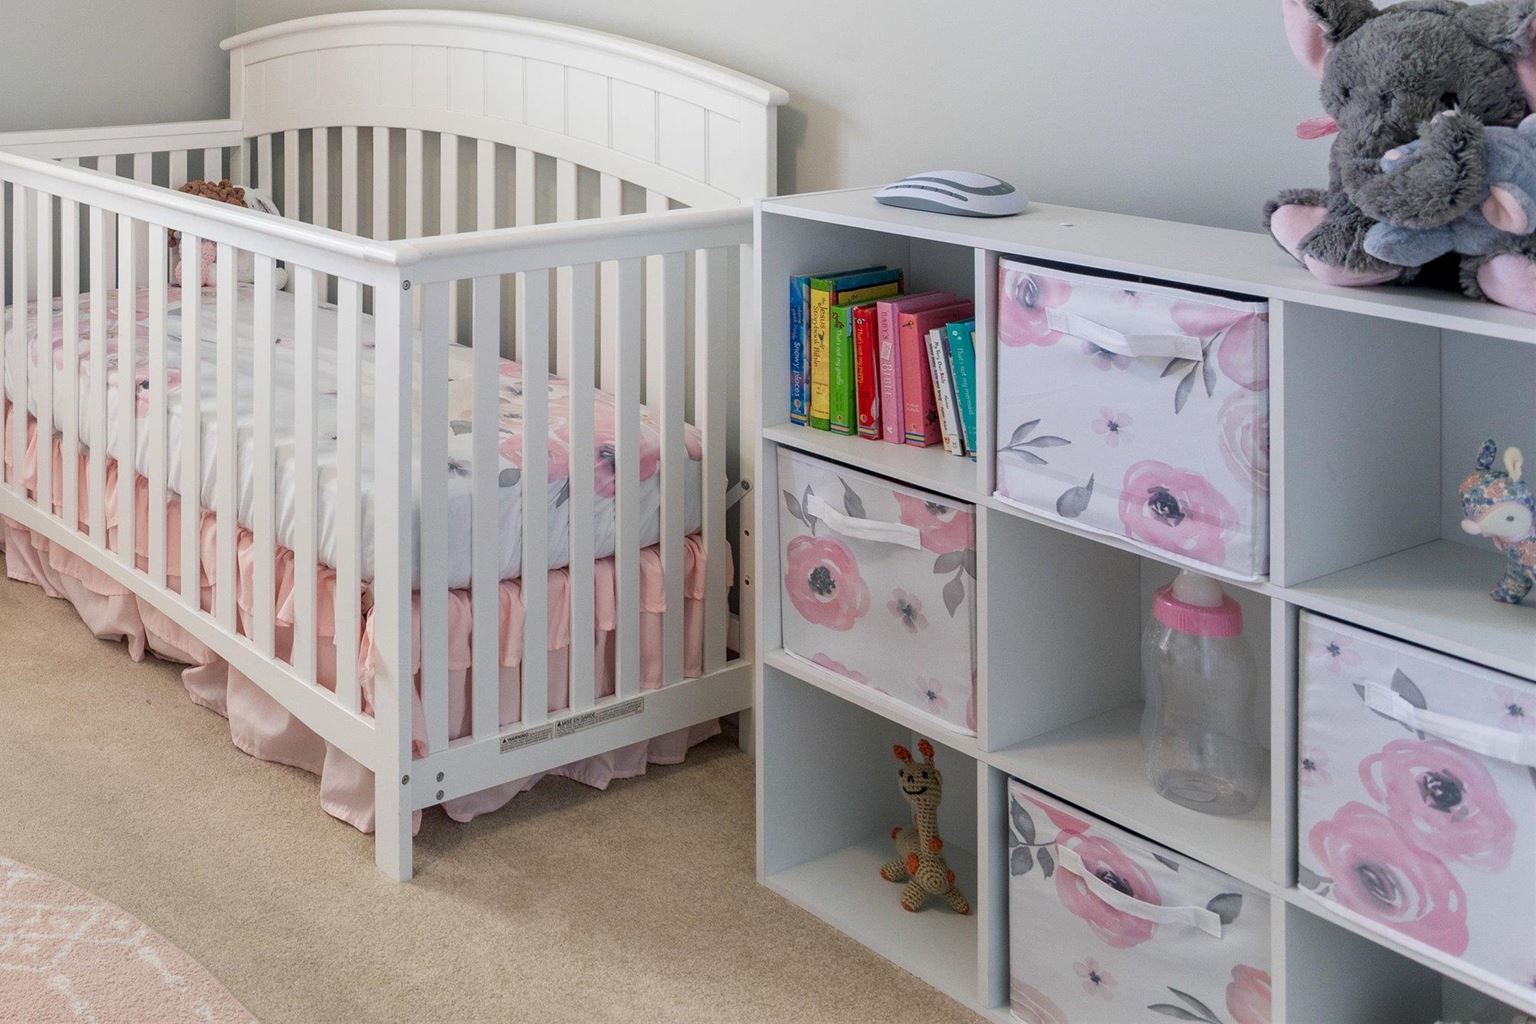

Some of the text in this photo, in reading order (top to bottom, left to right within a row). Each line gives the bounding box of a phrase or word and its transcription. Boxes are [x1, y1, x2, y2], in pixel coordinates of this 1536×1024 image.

[812, 305, 820, 345] Storybook
[818, 302, 828, 329] Jesus
[880, 311, 889, 340] BABY'S
[792, 342, 802, 397] Snowy places
[881, 363, 894, 398] BIBLE
